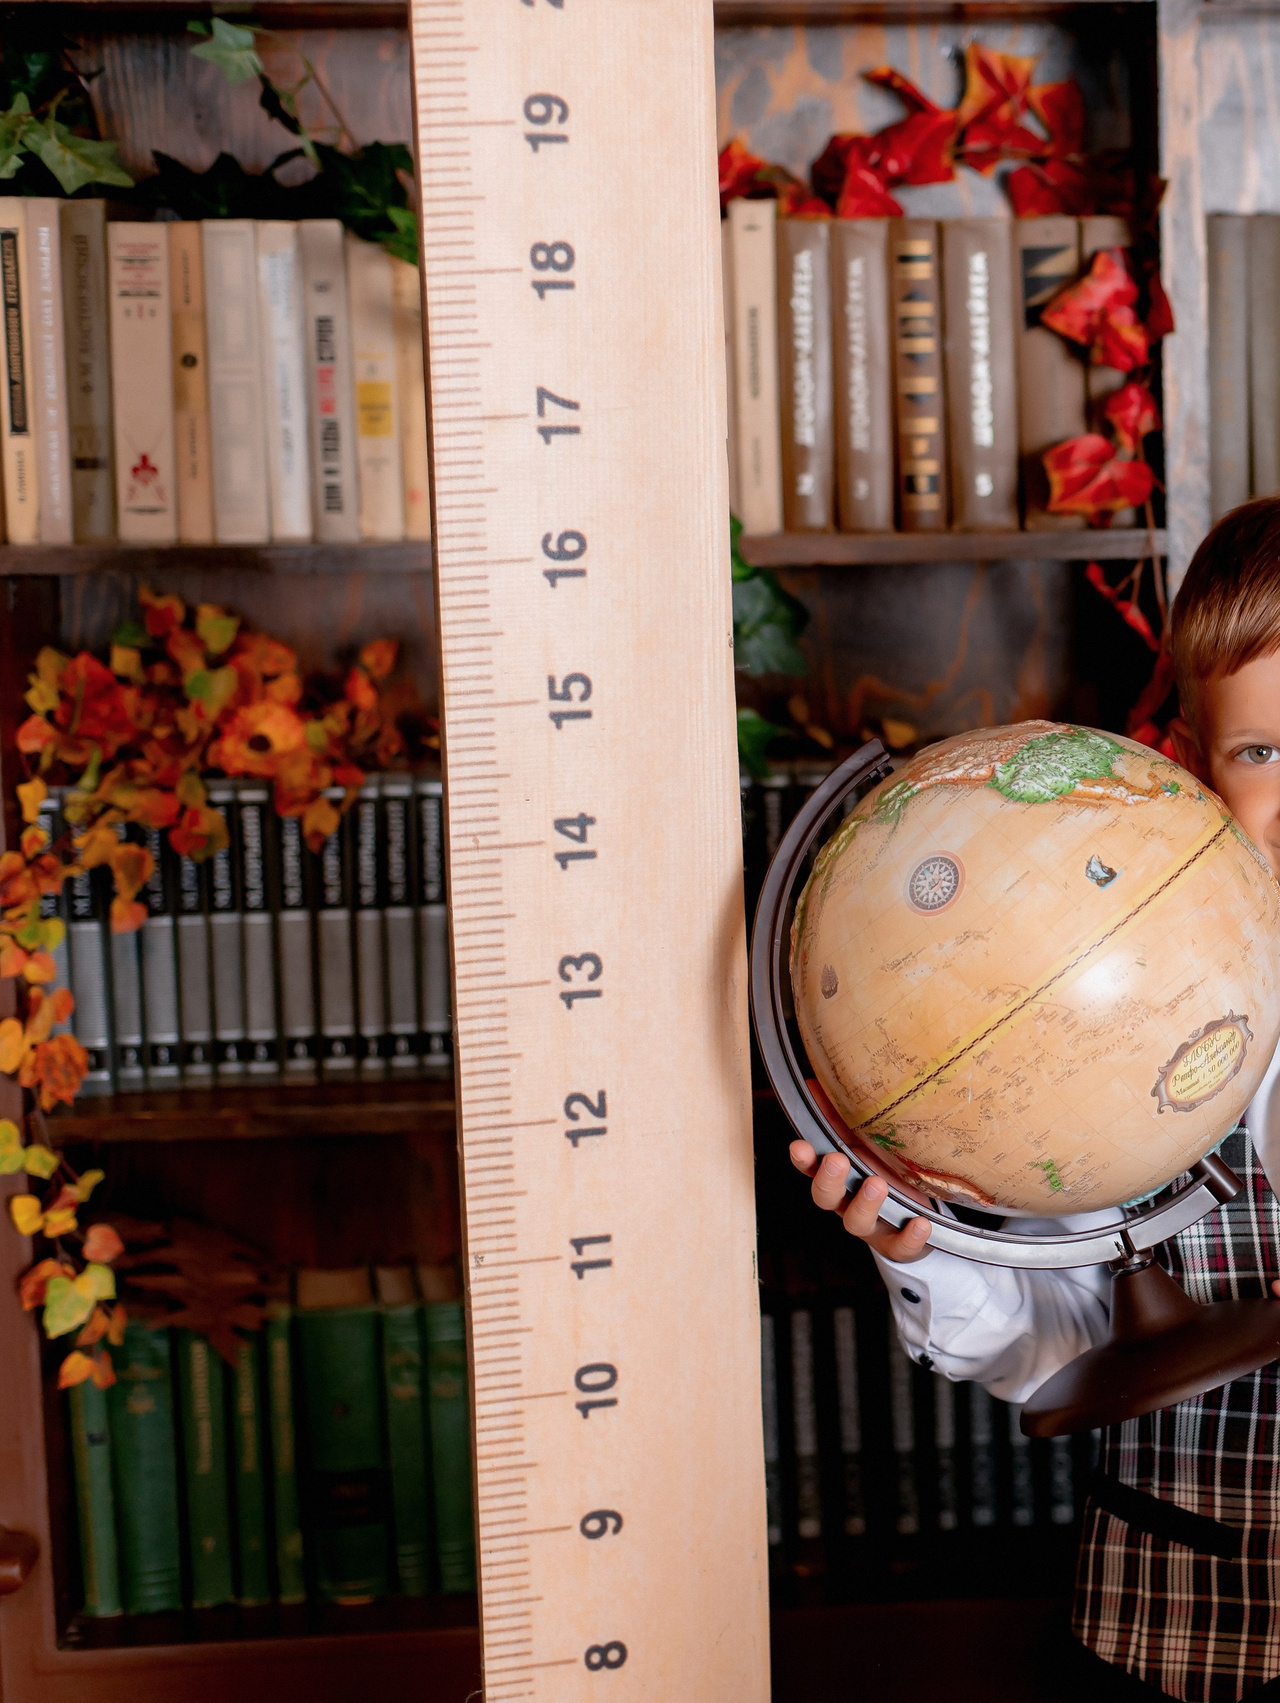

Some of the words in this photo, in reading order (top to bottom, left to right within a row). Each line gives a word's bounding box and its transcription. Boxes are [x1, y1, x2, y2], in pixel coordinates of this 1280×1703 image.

[524, 95, 568, 151] 19
[530, 242, 574, 299] 18
[536, 388, 580, 444] 17
[542, 531, 587, 588] 16
[548, 673, 592, 730] 15
[554, 813, 597, 870] 14
[558, 953, 603, 1010] 13
[1182, 1028, 1222, 1067] ГЛОБУС
[1230, 1040, 1239, 1055] 000
[564, 1090, 607, 1148] 12
[569, 1234, 612, 1280] 11
[574, 1363, 618, 1420] 10
[579, 1509, 623, 1540] 9
[584, 1640, 628, 1672] 8
